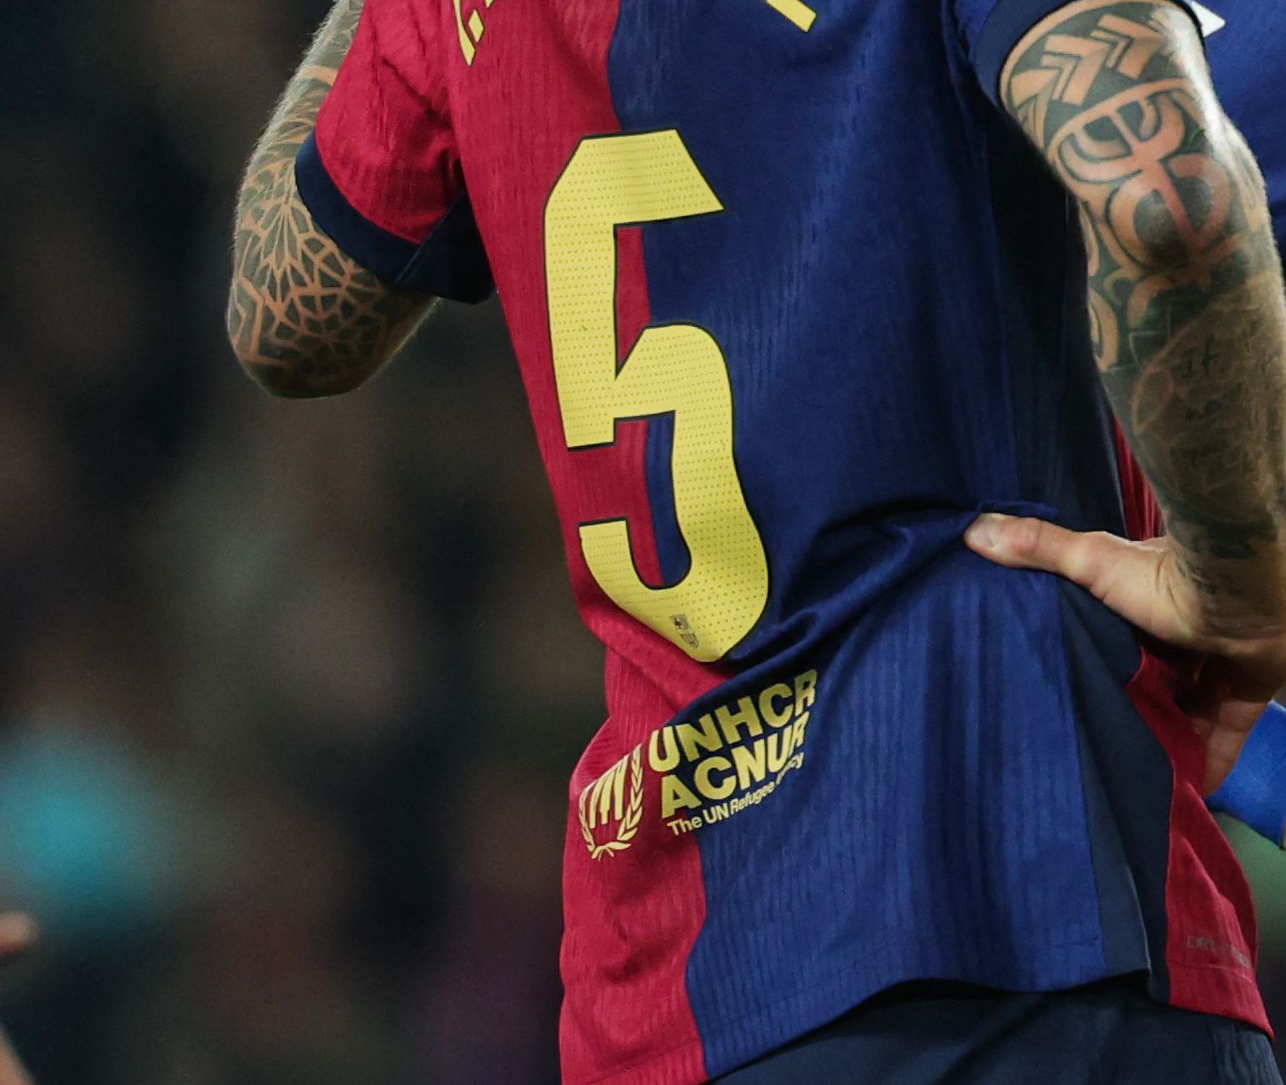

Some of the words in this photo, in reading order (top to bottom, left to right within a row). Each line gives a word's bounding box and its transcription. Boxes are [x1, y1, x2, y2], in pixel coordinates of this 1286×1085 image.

[543, 127, 770, 664] 5
[648, 669, 819, 773] UNHCR
[661, 710, 810, 819] ACNUR
[667, 818, 703, 836] The
[702, 802, 730, 825] UN
